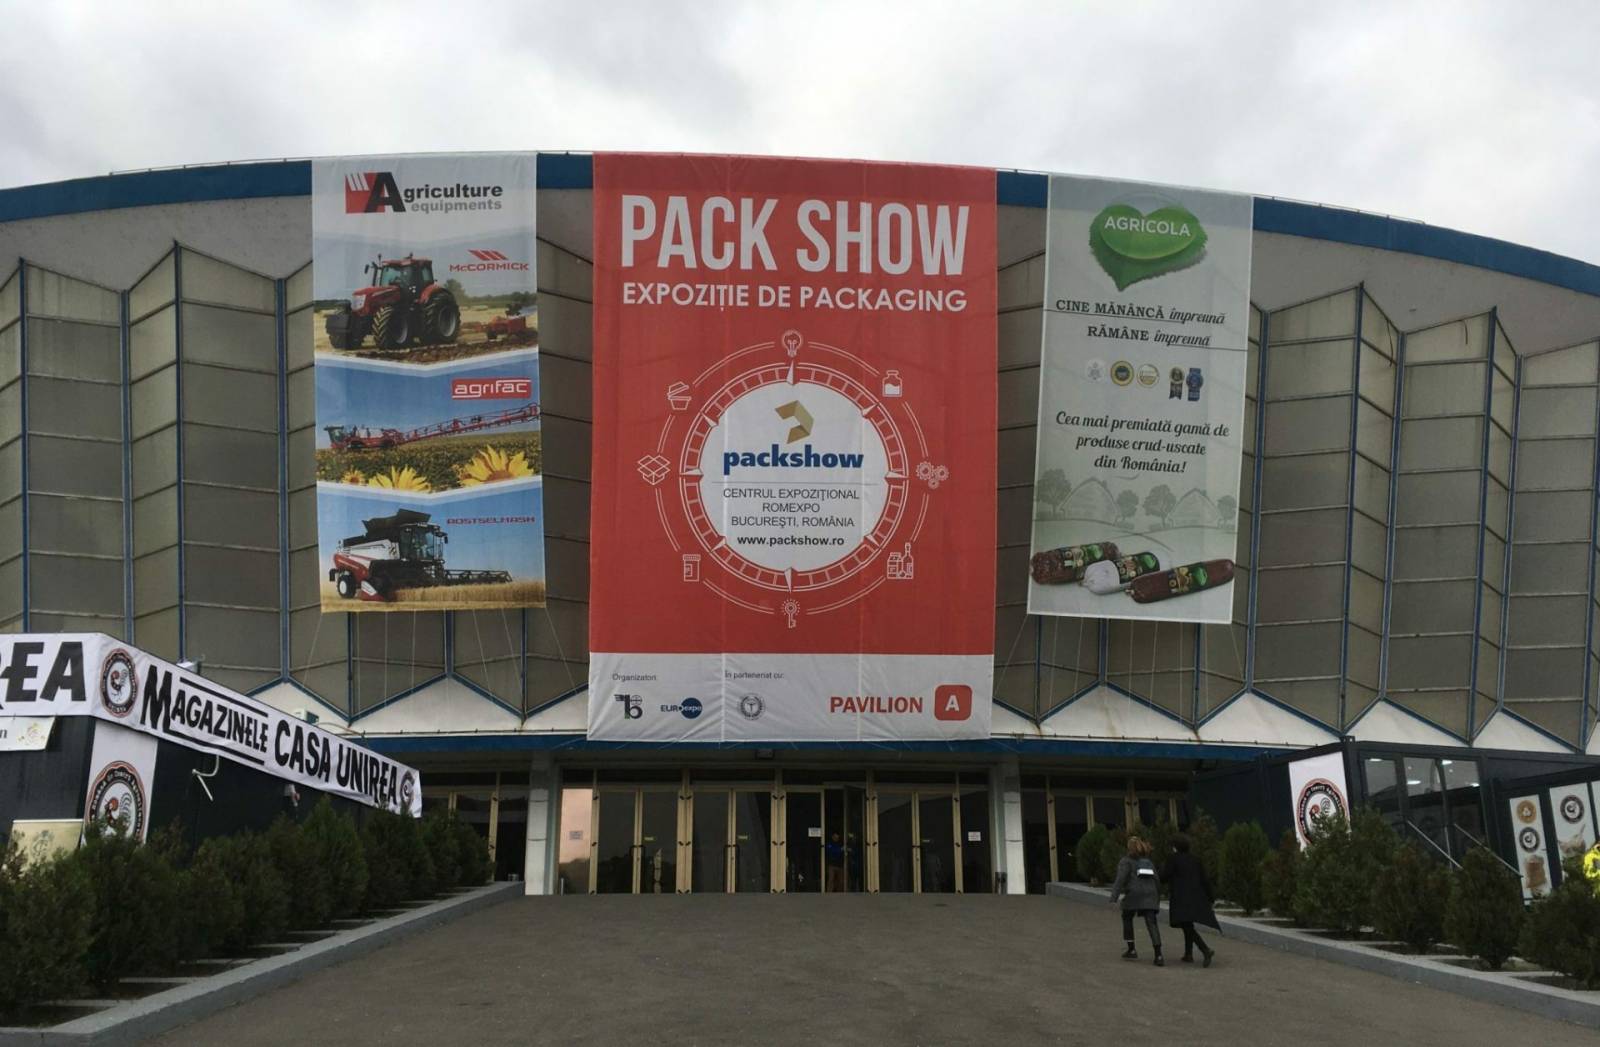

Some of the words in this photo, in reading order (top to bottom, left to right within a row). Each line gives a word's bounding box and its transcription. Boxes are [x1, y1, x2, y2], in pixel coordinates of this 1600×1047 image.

[411, 199, 502, 214] equipments
[621, 194, 779, 271] PACK
[796, 199, 970, 276] SHOW
[1104, 216, 1191, 237] AGRICOLA
[758, 286, 791, 308] DE
[799, 287, 967, 312] PACKAGING
[1056, 300, 1090, 313] CINE
[453, 379, 530, 399] agrifac
[1056, 411, 1080, 426] Cea
[1083, 415, 1108, 429] mai
[1213, 424, 1229, 437] de
[1076, 435, 1129, 451] produse
[1132, 437, 1206, 457] crud-uscate
[723, 443, 864, 476] packshow
[1094, 456, 1117, 470] din
[723, 488, 776, 499] CENTRUL
[762, 502, 820, 513] ROMEXPO
[802, 515, 855, 527] ROMÂNIA
[736, 535, 845, 547] www.packshow.ro
[0, 641, 87, 711] EA
[830, 697, 922, 713] PAVILION
[944, 694, 960, 711] A
[274, 720, 330, 784] CASA
[336, 741, 398, 806] UNIREA
